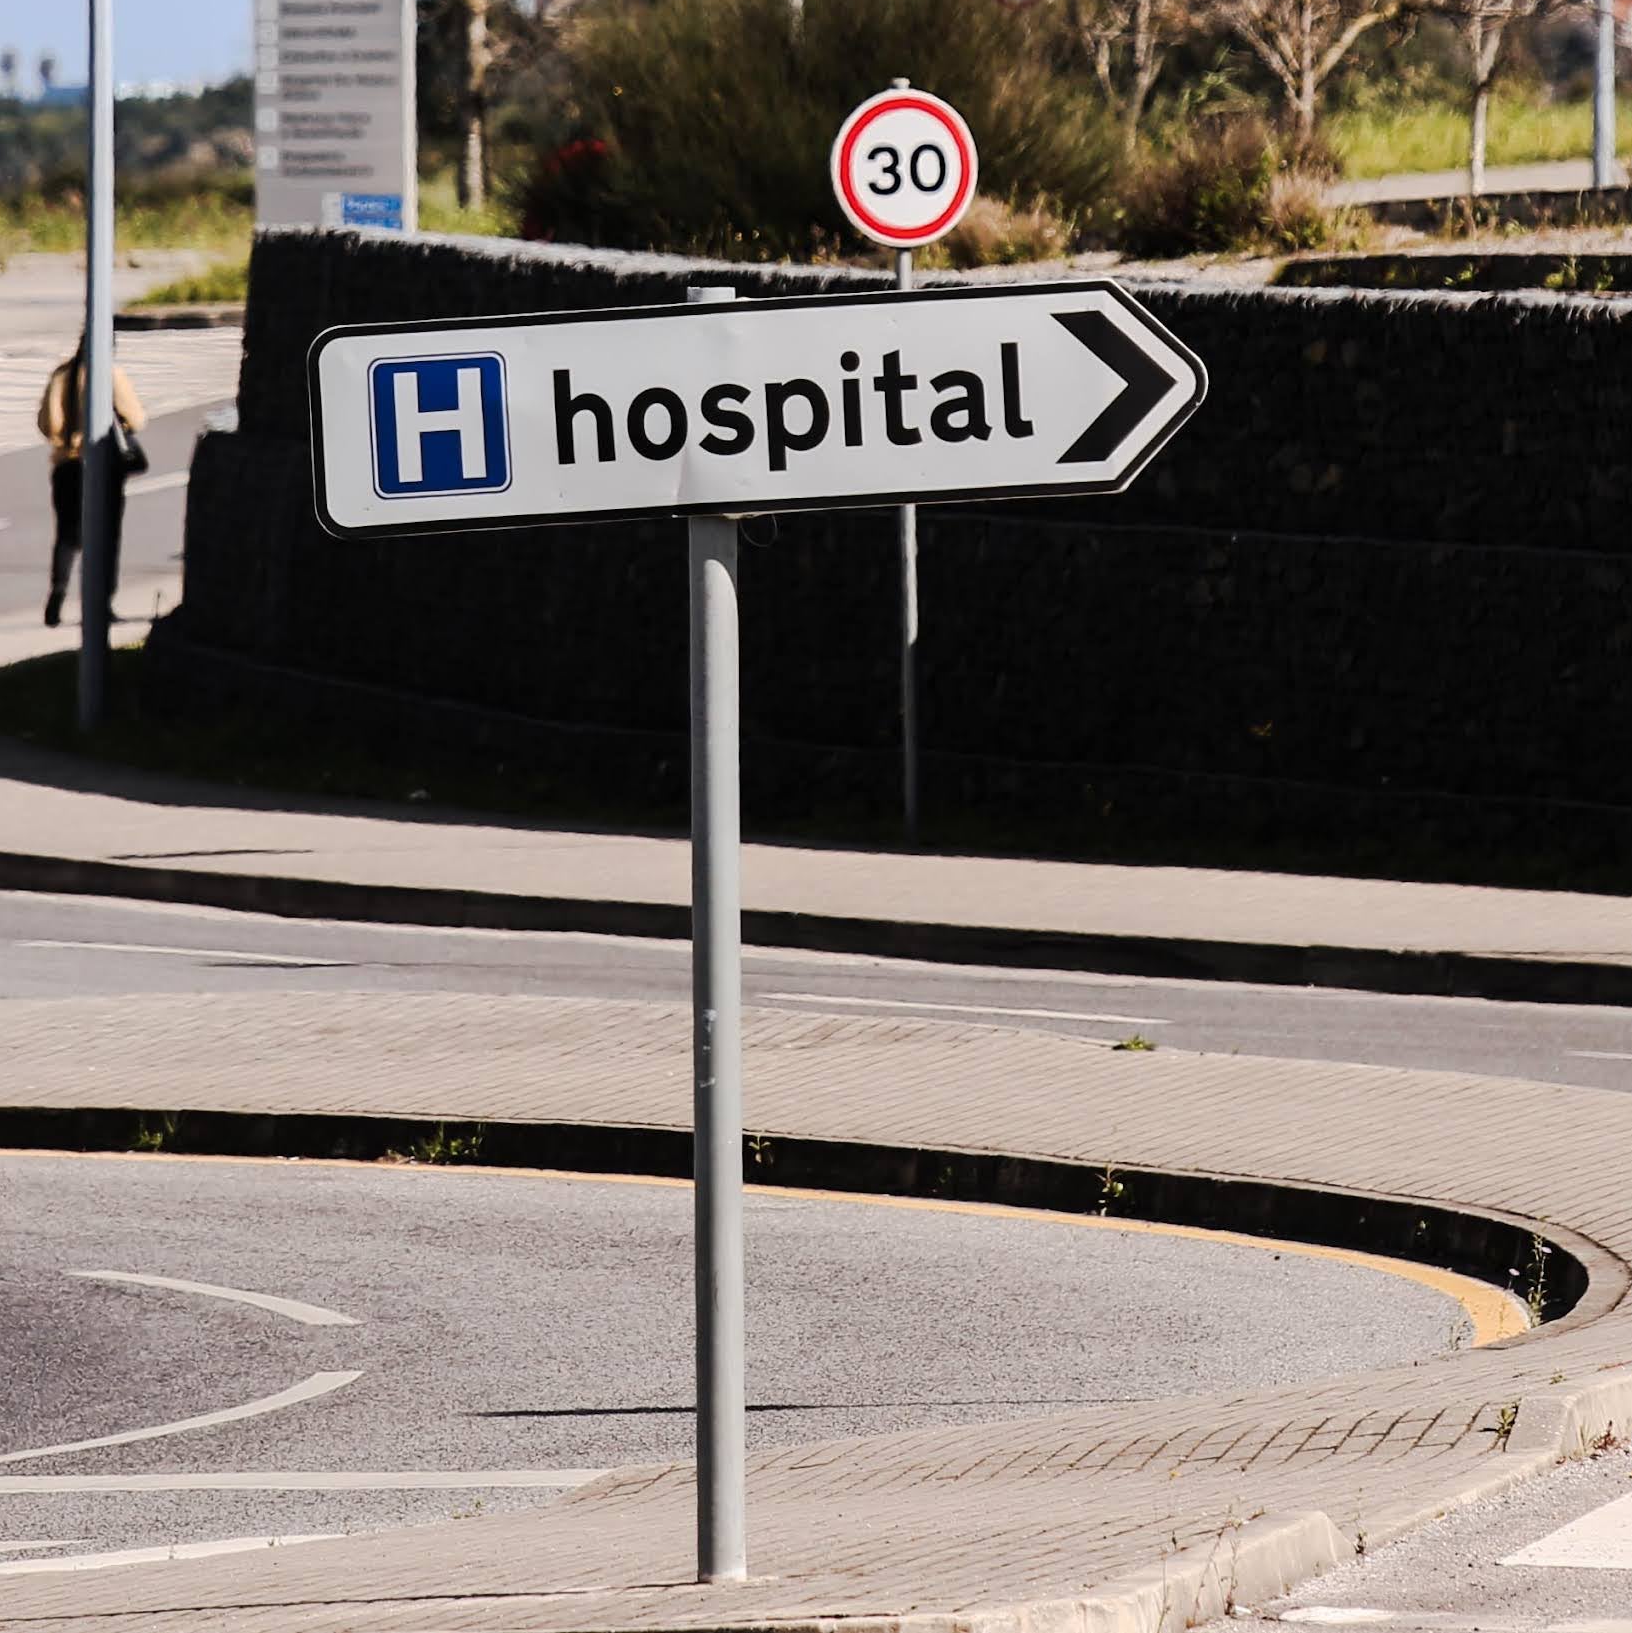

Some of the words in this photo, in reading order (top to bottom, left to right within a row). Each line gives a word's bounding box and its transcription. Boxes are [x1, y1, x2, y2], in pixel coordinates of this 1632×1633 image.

[866, 143, 948, 197] 30
[392, 367, 488, 484] H
[553, 341, 1035, 473] hospital
